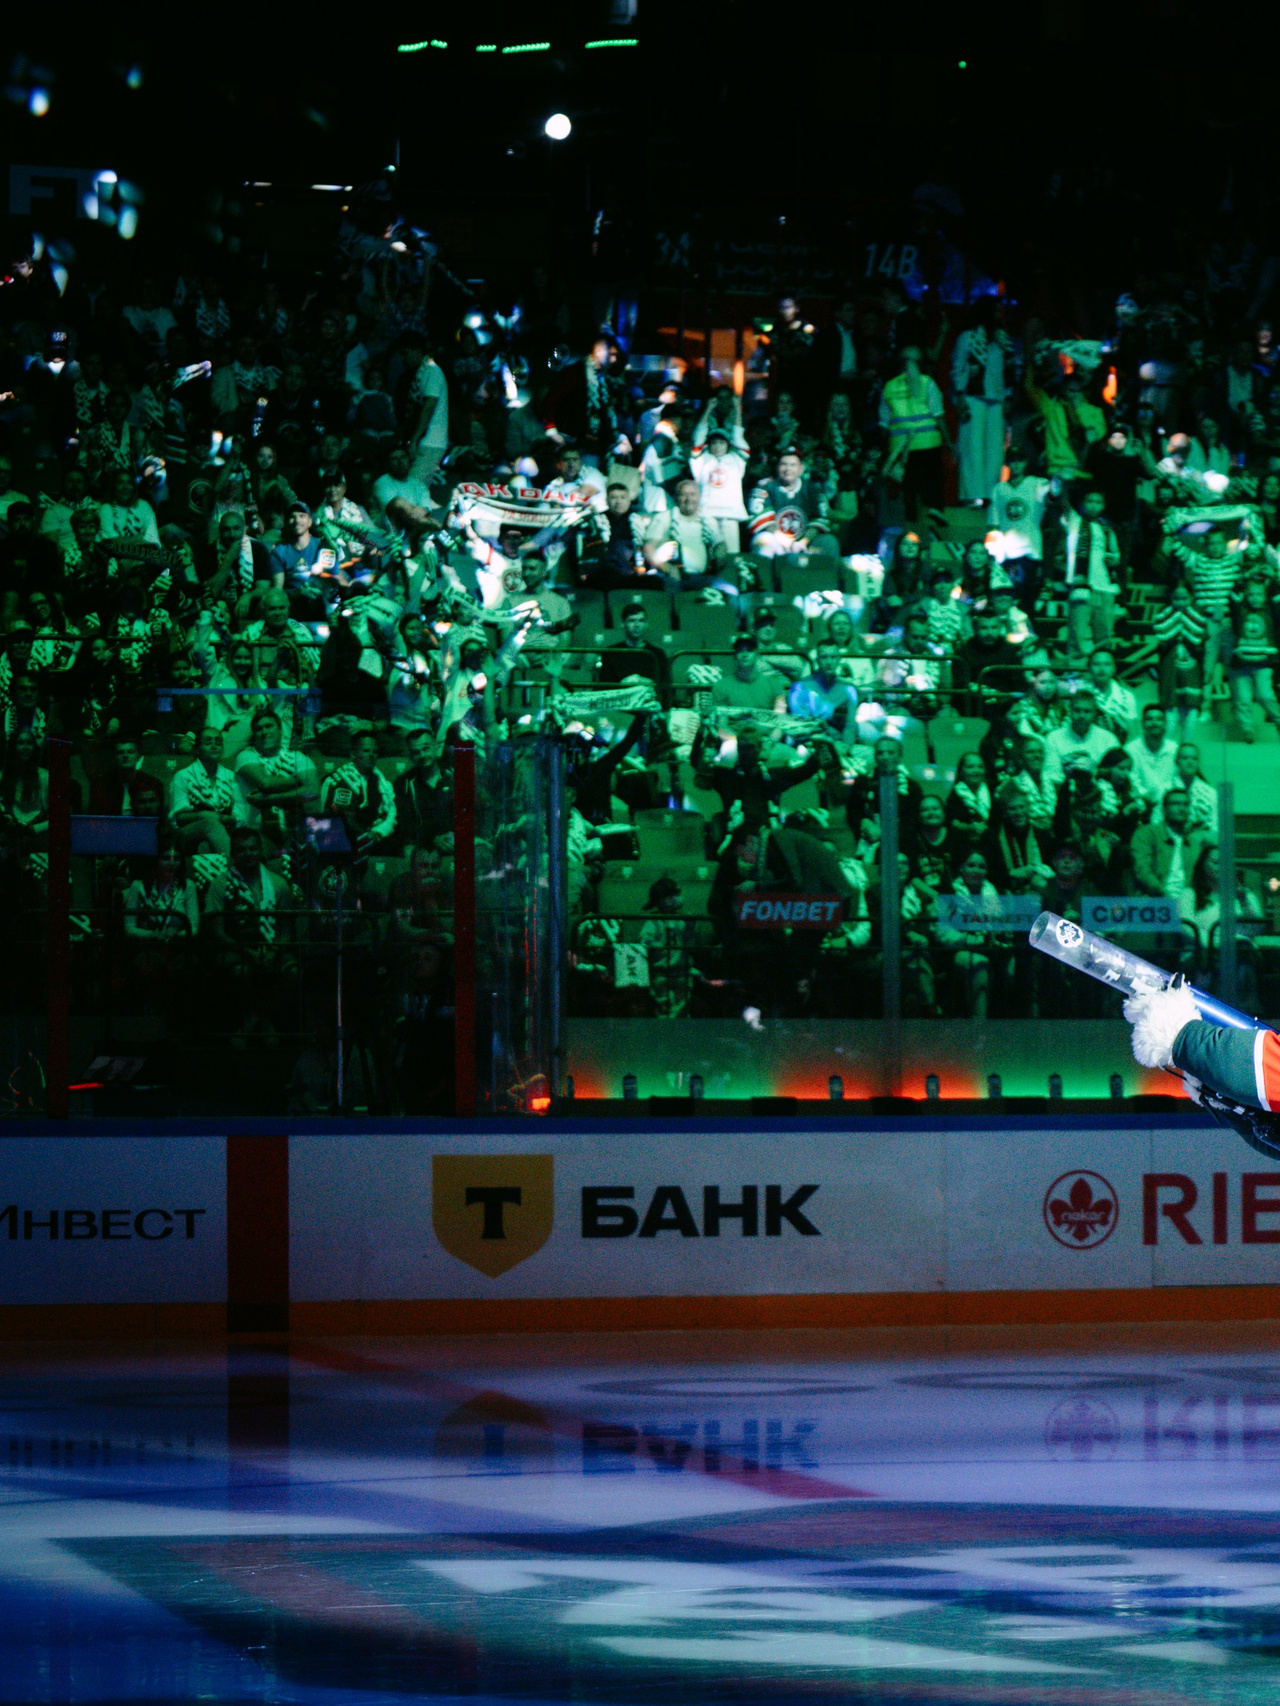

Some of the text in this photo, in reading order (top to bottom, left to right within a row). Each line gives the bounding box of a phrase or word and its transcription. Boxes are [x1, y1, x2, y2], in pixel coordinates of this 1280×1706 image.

[740, 900, 840, 921] FONBET
[465, 1185, 822, 1239] Т БАНК
